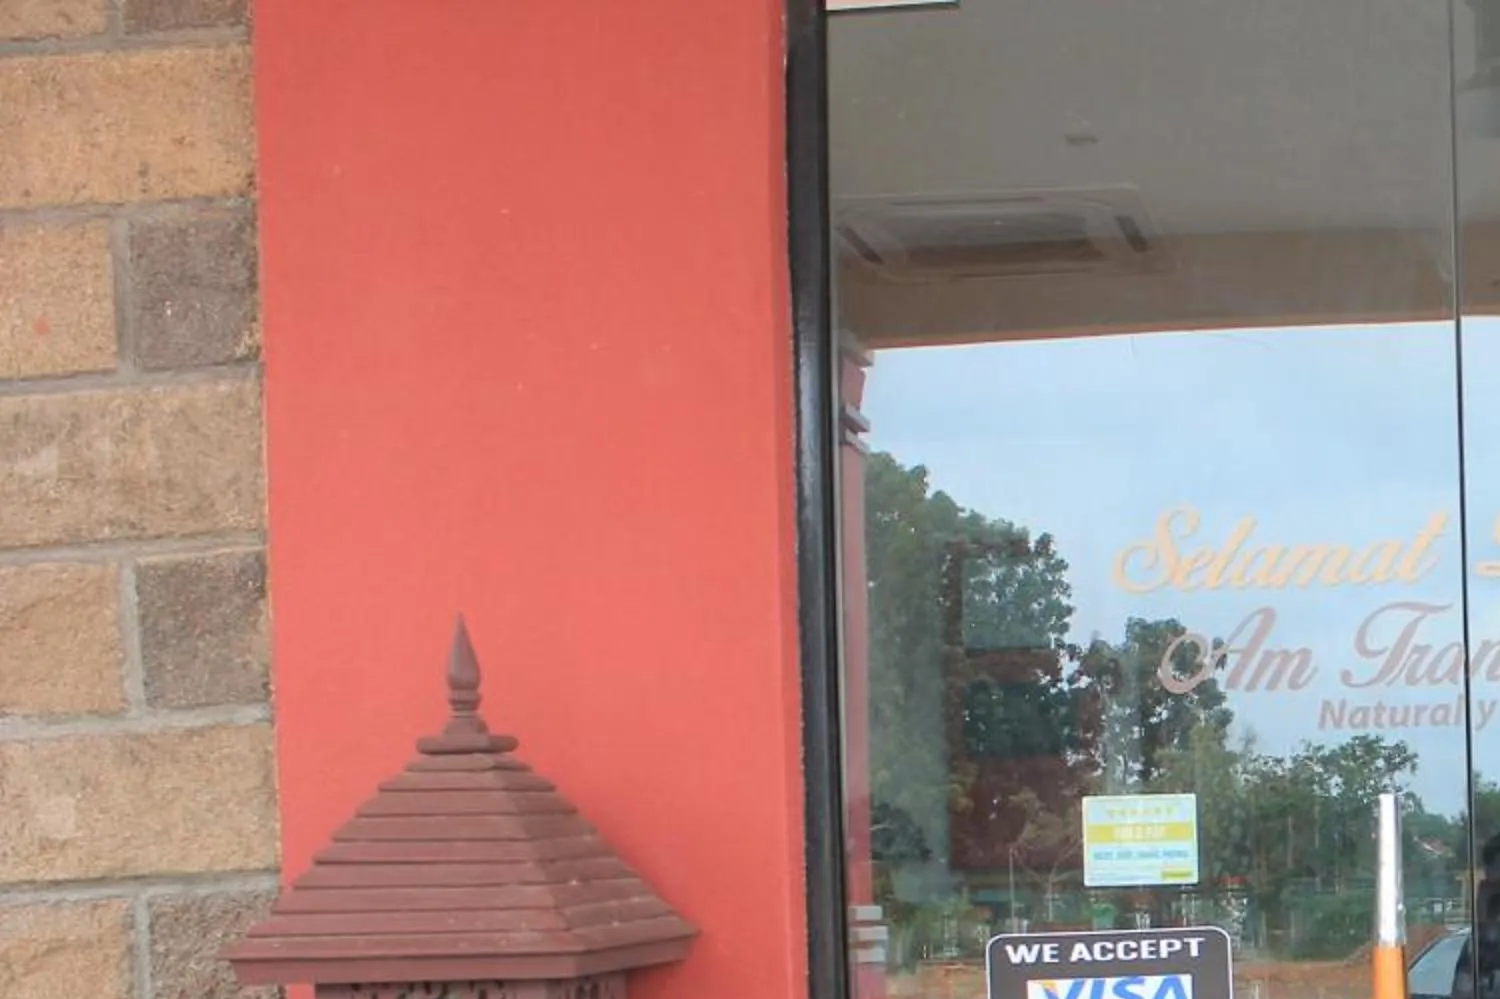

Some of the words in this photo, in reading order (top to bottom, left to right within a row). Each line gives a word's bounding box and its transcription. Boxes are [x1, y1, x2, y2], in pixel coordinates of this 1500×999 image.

[1113, 505, 1449, 594] Selamat
[1318, 692, 1497, 731] Naturaly
[1005, 944, 1059, 964] WE
[1070, 937, 1205, 962] ACCEPT
